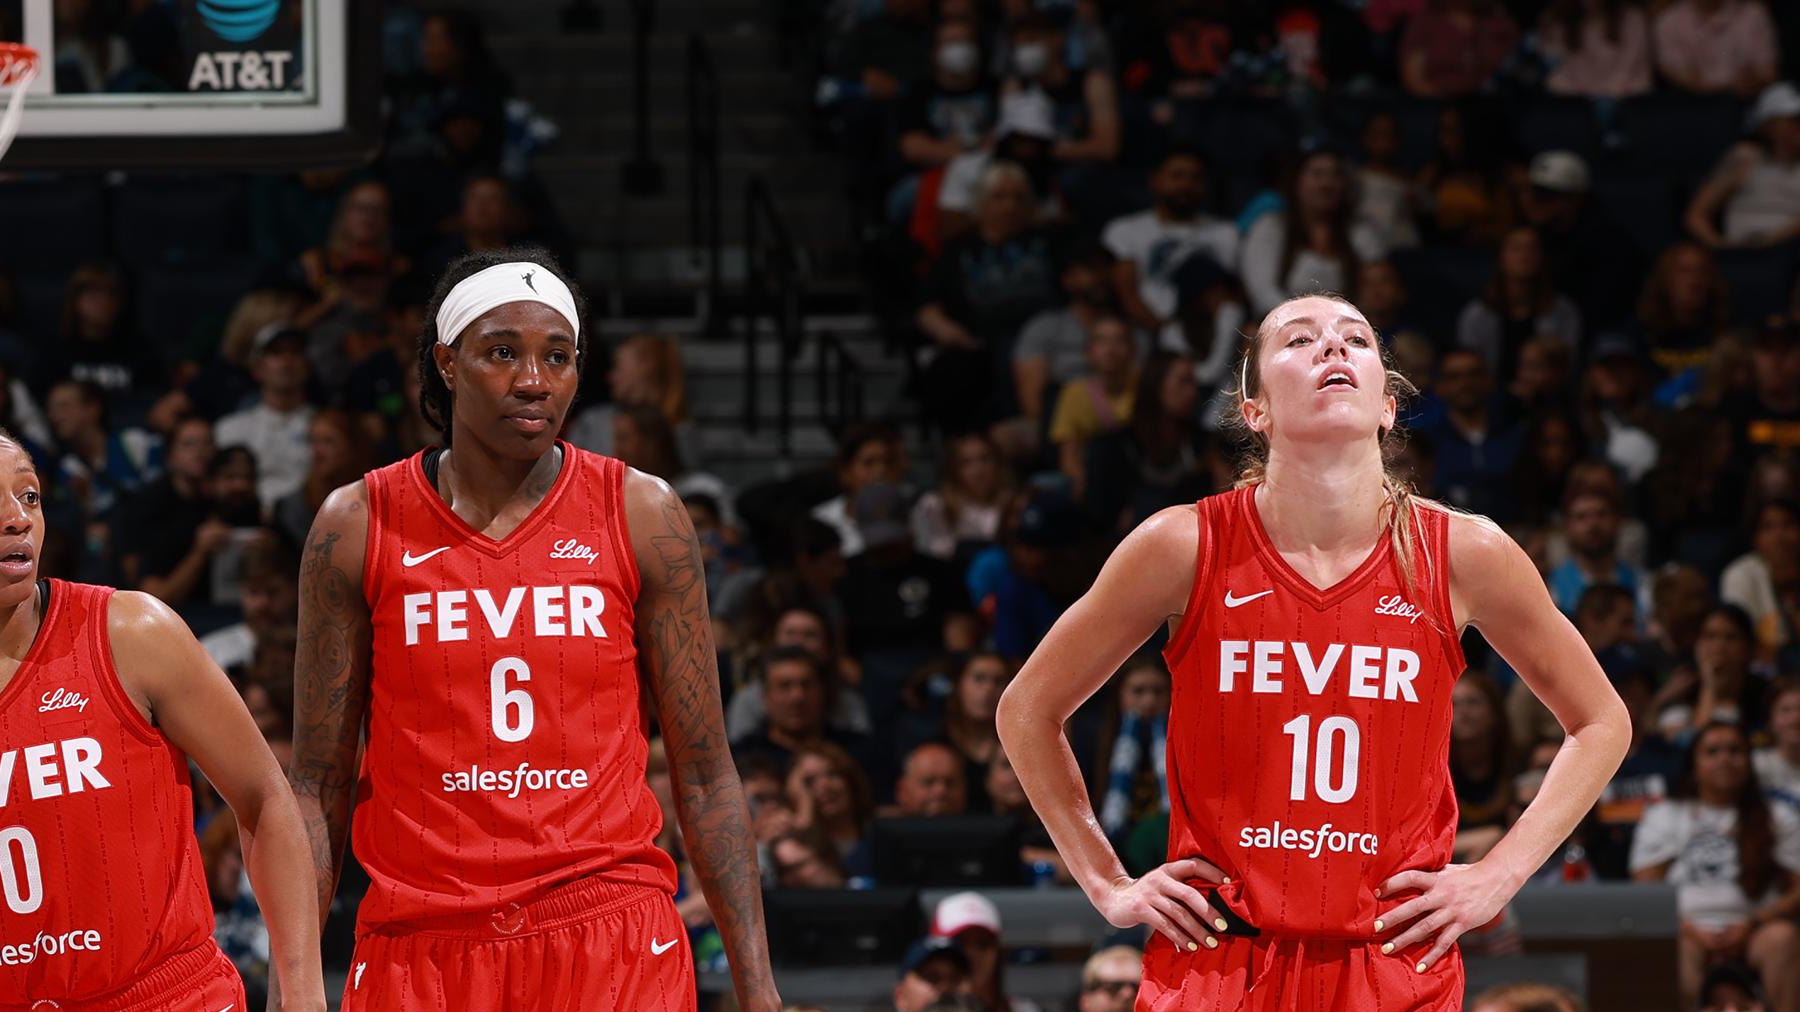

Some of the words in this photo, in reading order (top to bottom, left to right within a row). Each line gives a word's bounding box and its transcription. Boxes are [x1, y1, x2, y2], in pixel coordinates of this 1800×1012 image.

[188, 50, 293, 91] AT&T
[549, 538, 600, 565] Lilly
[403, 585, 608, 646] FEVER
[1374, 595, 1422, 624] Lilly
[1219, 640, 1421, 703] FEVER
[38, 687, 90, 713] Lilly
[490, 656, 535, 743] 6
[1283, 714, 1360, 804] 10
[441, 762, 588, 799] salesforce
[1239, 820, 1378, 859] salesforce
